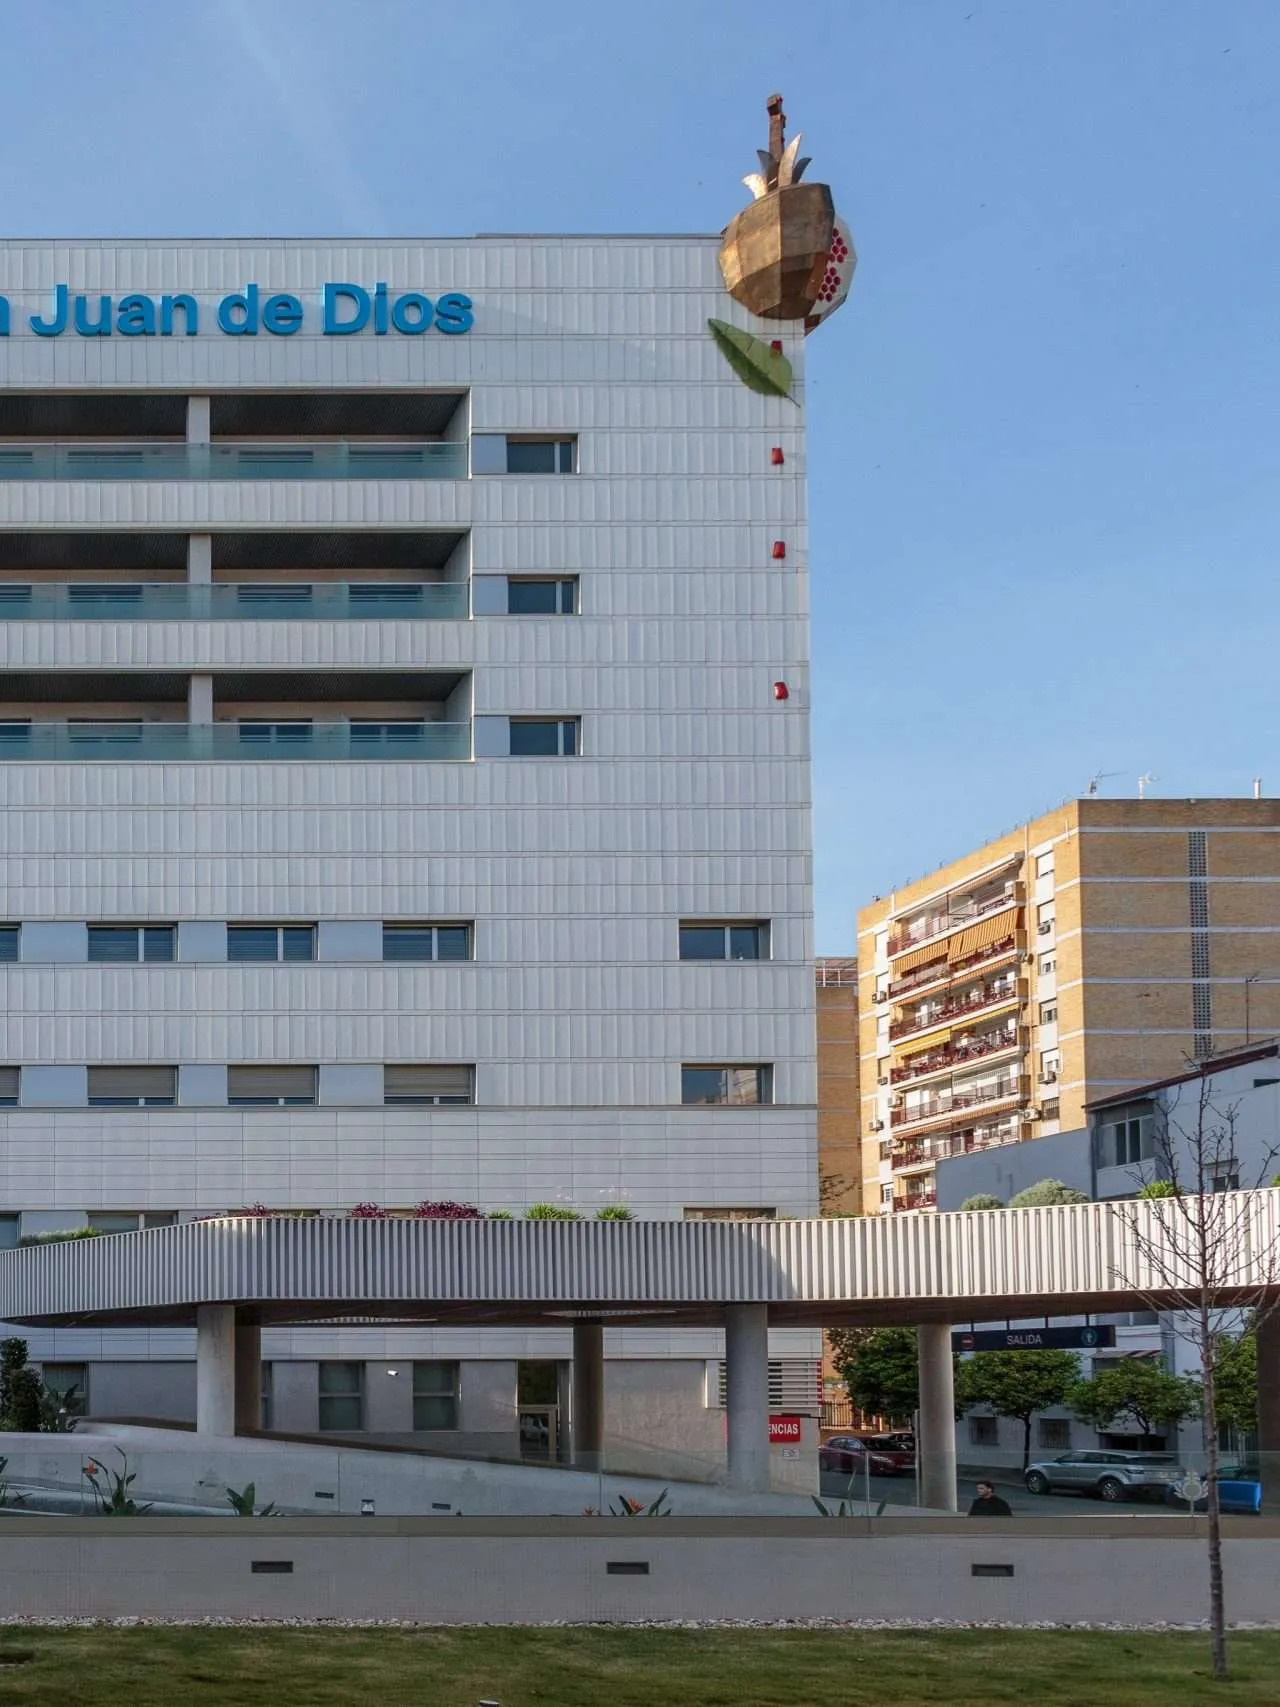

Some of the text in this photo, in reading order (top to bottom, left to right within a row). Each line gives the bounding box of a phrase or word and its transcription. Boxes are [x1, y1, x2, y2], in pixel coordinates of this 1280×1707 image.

[28, 284, 200, 336] Juan
[216, 283, 306, 336] de
[322, 282, 476, 335] Dios
[1007, 1335, 1042, 1345] SALIDA
